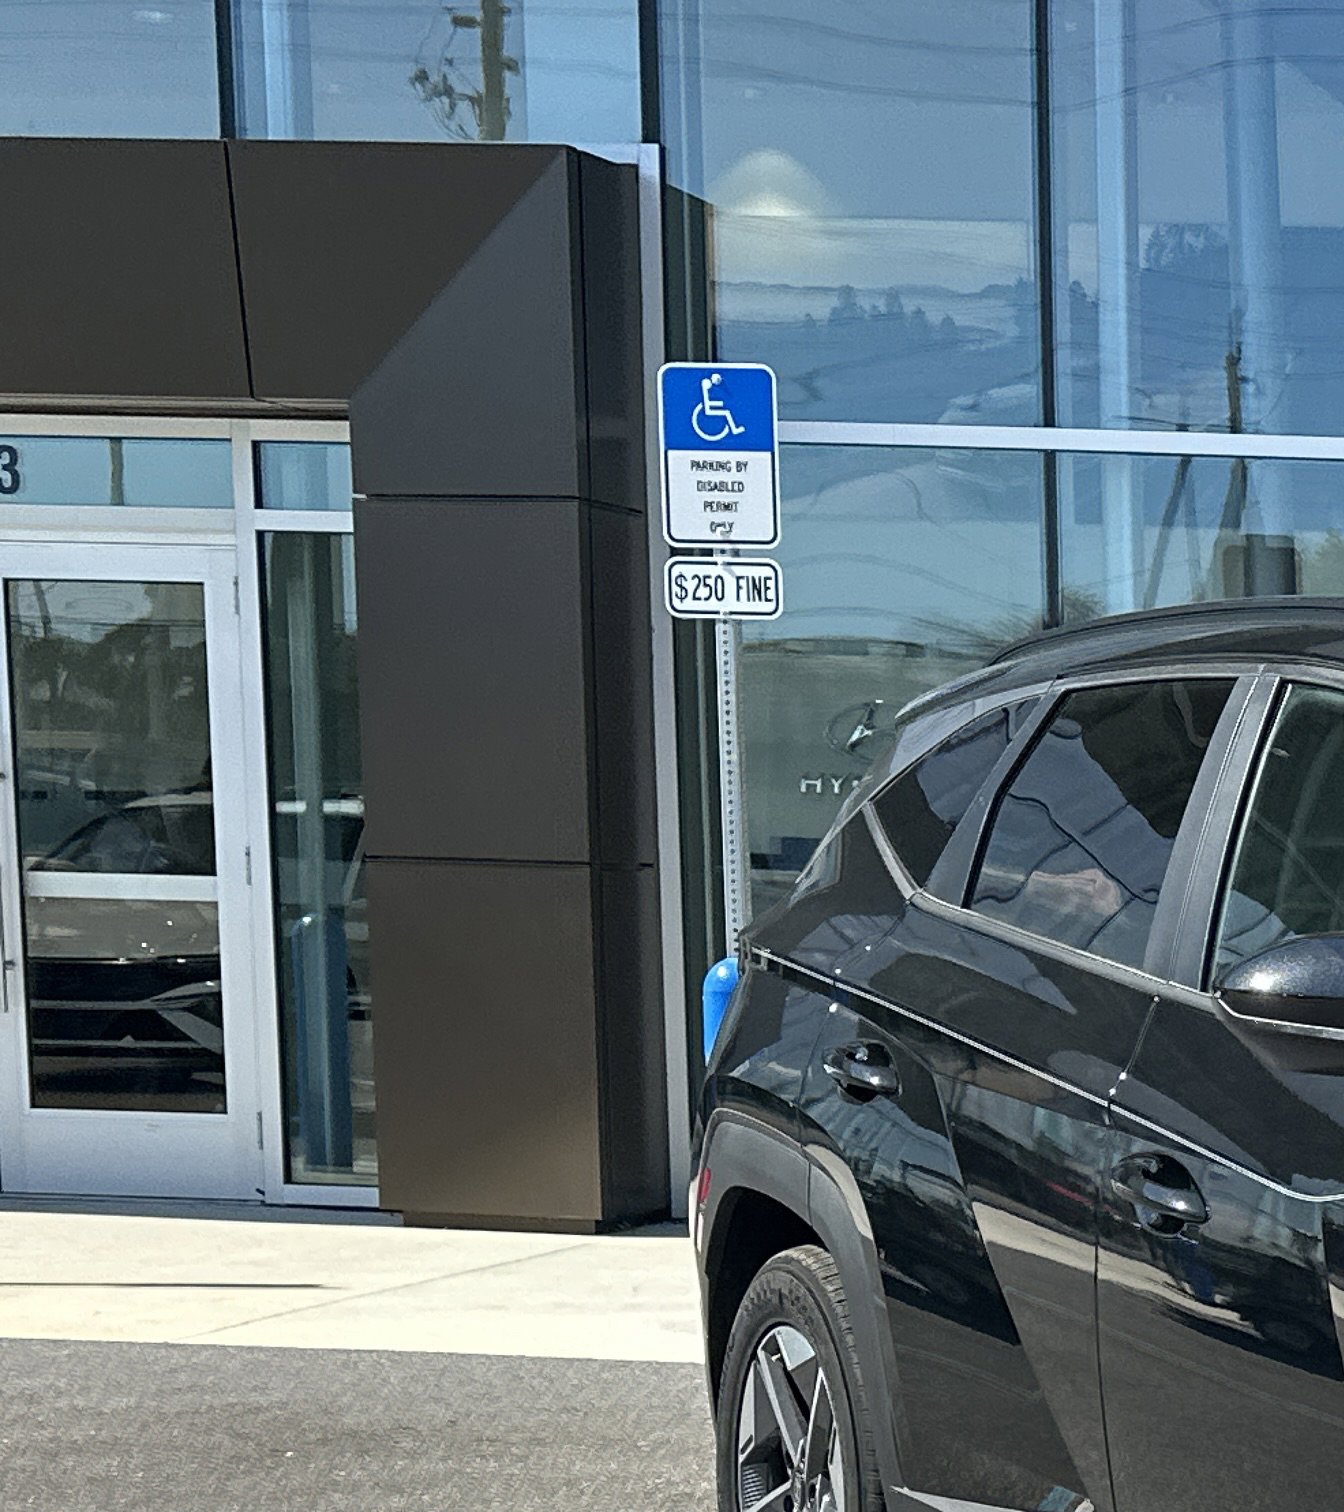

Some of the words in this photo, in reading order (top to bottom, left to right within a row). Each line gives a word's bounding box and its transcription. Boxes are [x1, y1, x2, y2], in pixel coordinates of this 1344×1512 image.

[690, 460, 732, 472] PARKING
[736, 461, 749, 472] BY
[696, 480, 745, 493] DISABLED
[703, 501, 740, 513] PERMIT
[674, 572, 725, 604] $250
[735, 575, 774, 602] FINE
